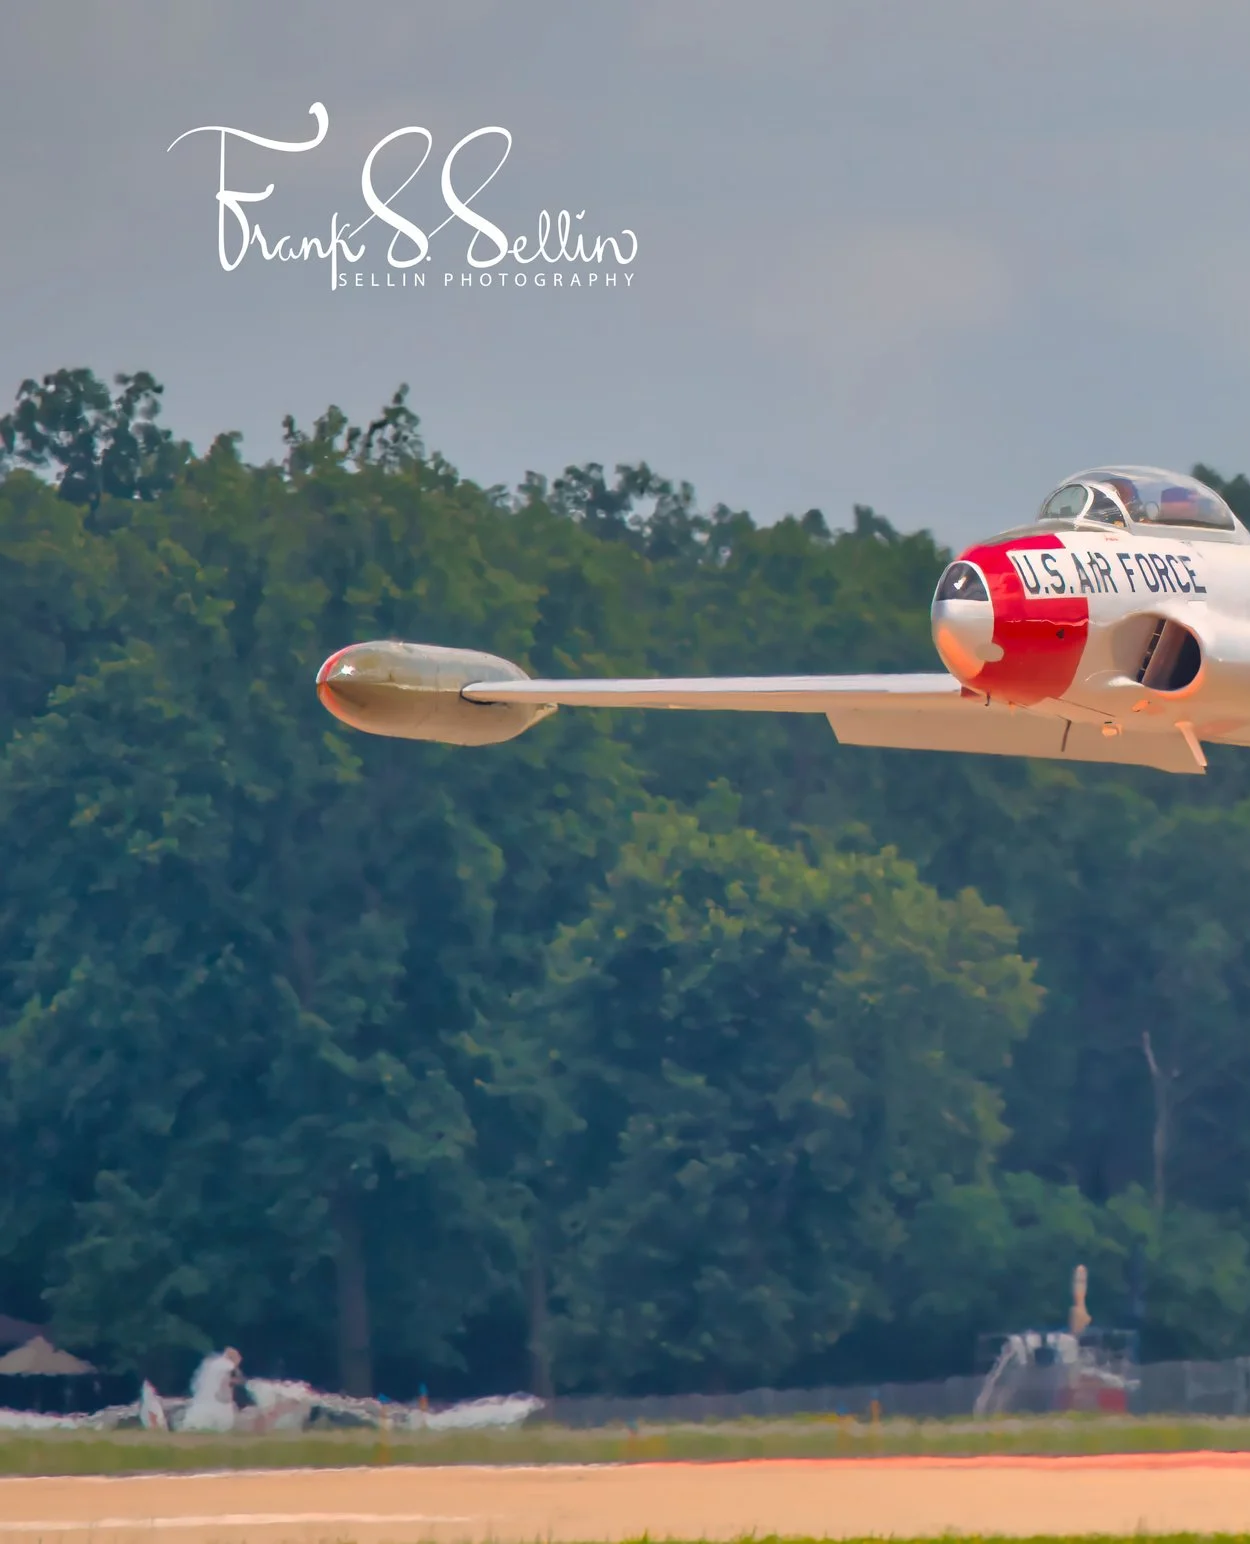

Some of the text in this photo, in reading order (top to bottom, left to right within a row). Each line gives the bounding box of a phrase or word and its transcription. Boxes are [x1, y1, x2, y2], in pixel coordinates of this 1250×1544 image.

[1011, 551, 1208, 595] U.S. AIR FORCE
